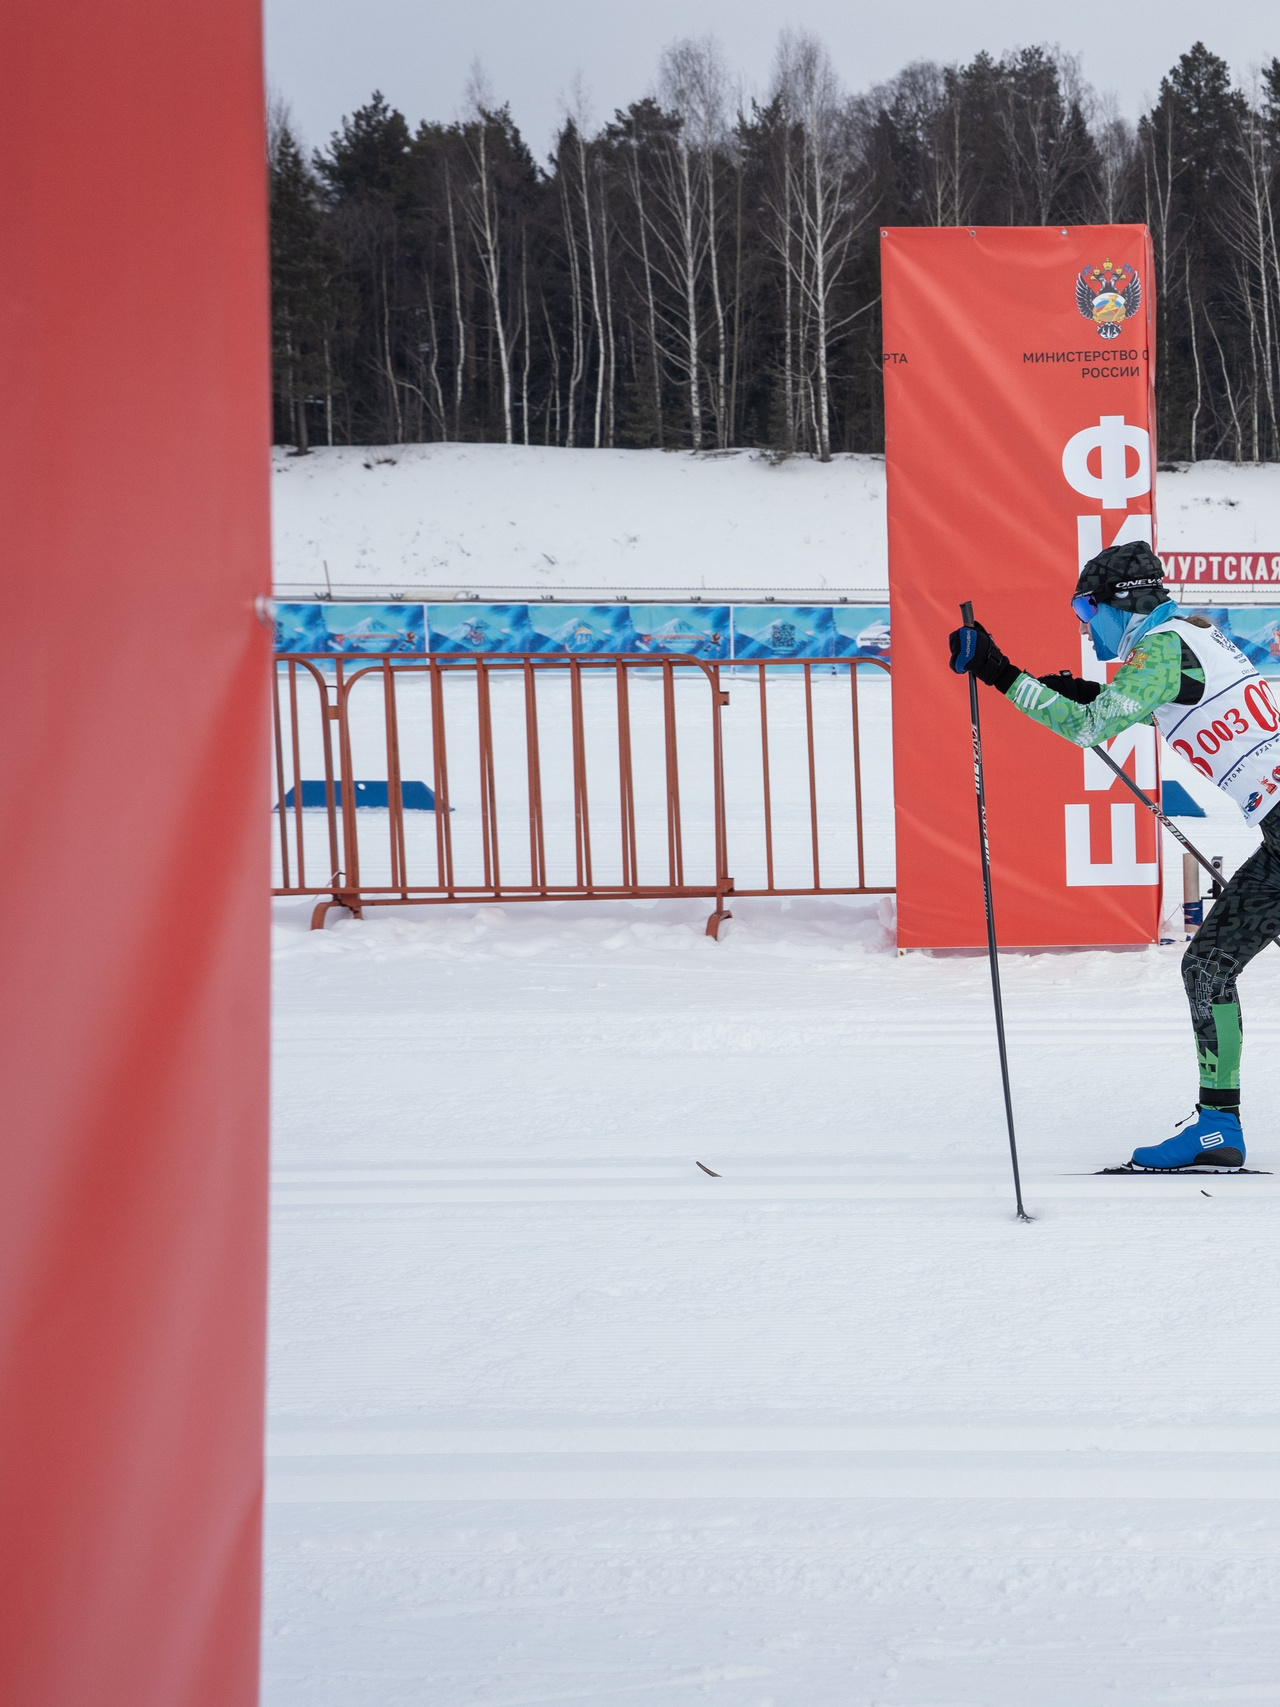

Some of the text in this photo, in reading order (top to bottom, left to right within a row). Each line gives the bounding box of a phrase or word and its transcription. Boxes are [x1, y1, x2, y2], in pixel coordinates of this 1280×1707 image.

[1023, 350, 1138, 364] МИНИСТЕРСТВО
[1082, 366, 1140, 379] РОССИИ
[1196, 708, 1250, 755] 003
